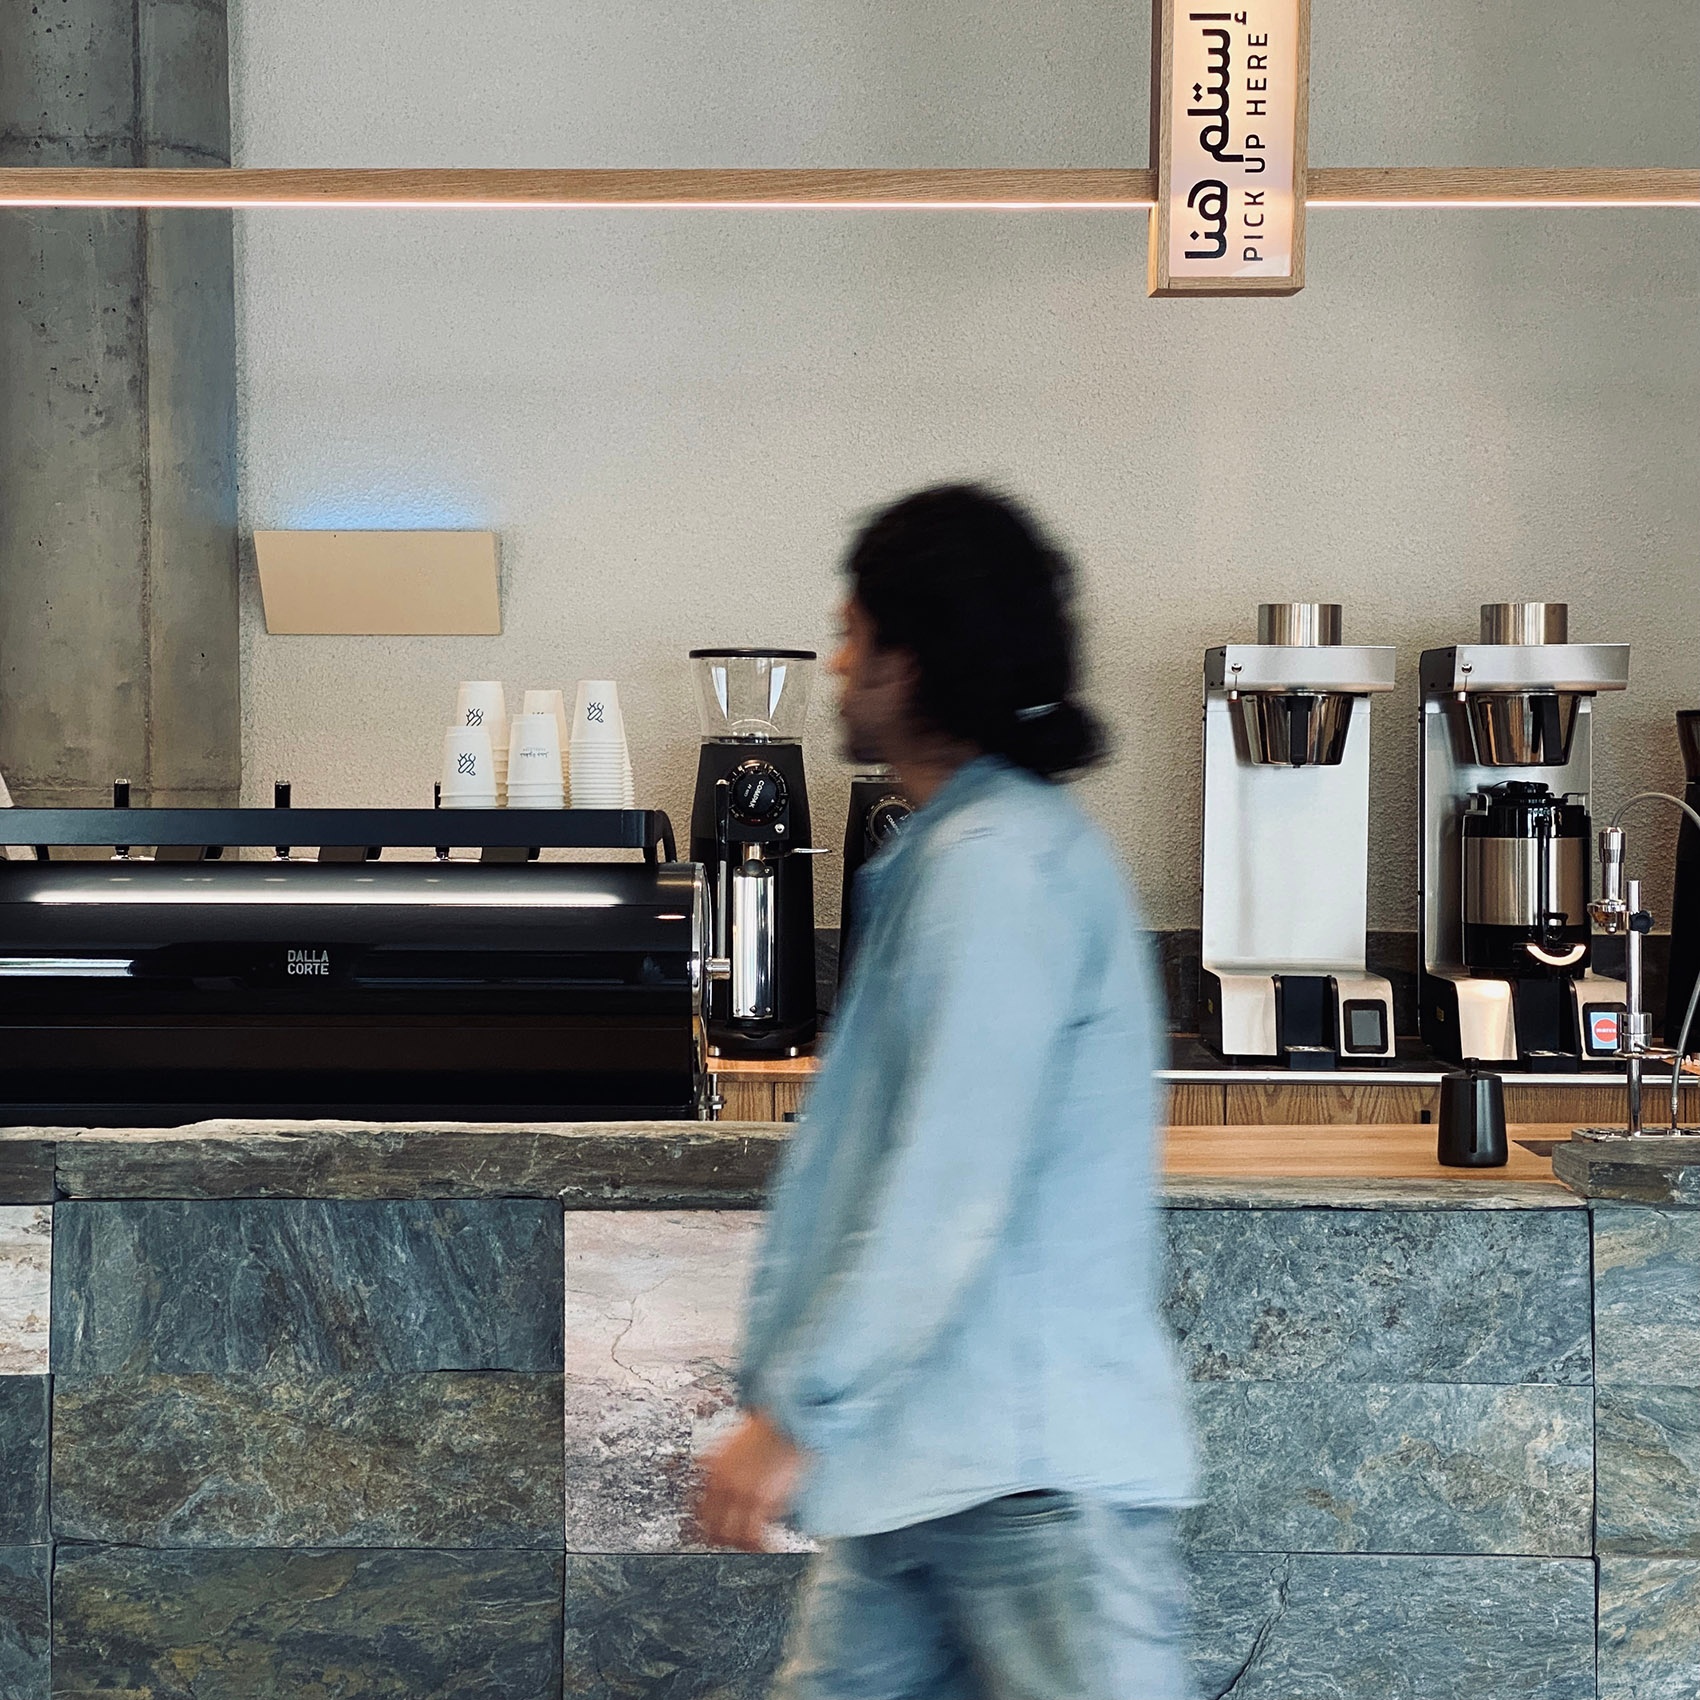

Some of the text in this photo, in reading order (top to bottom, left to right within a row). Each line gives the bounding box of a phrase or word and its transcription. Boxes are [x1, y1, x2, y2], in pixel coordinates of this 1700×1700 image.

[1184, 11, 1247, 260] إستلم هنا
[1243, 33, 1268, 262] PICK UP HERE
[748, 780, 765, 808] COMPAK
[287, 949, 329, 962] DALLA
[287, 963, 330, 975] CORTE
